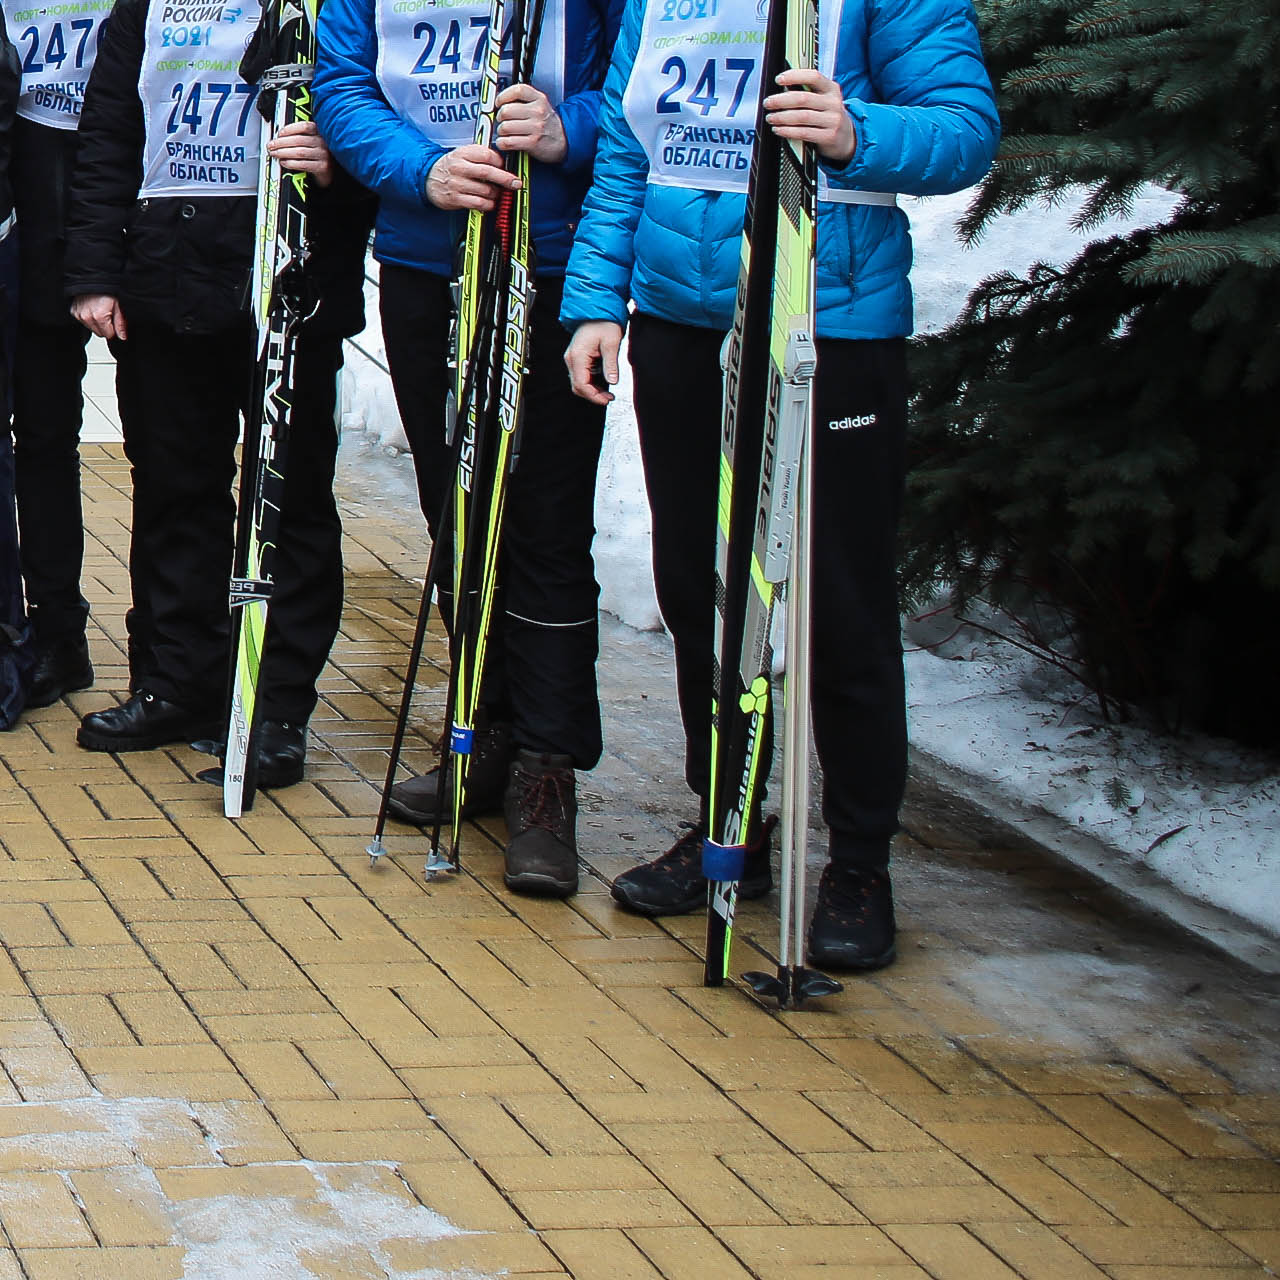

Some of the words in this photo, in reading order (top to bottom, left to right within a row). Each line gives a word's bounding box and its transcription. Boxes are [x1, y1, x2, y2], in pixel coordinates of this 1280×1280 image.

[89, 0, 116, 13] ЖИЗ
[163, 6, 224, 24] РОССИИ
[20, 18, 106, 74] 247
[161, 25, 213, 48] 2021
[28, 81, 85, 98] РЯНСК
[418, 78, 507, 101] БРЯНСКЯ
[656, 56, 756, 118] 247
[34, 90, 81, 115] ОБЛАС
[167, 82, 260, 137] 2477
[429, 102, 480, 122] ОБЛАС
[664, 123, 756, 146] БРЯНСКАЯ
[166, 141, 245, 163] БРЯНСКАЯ
[663, 146, 748, 170] ОБЛАСТЬ
[169, 162, 239, 184] ОБЛАСТЬ
[498, 258, 528, 432] FISCHER
[724, 276, 748, 448] SABLE
[829, 412, 877, 431] adidas
[758, 368, 780, 537] SABLE
[231, 693, 247, 755] STC
[738, 711, 759, 812] classic
